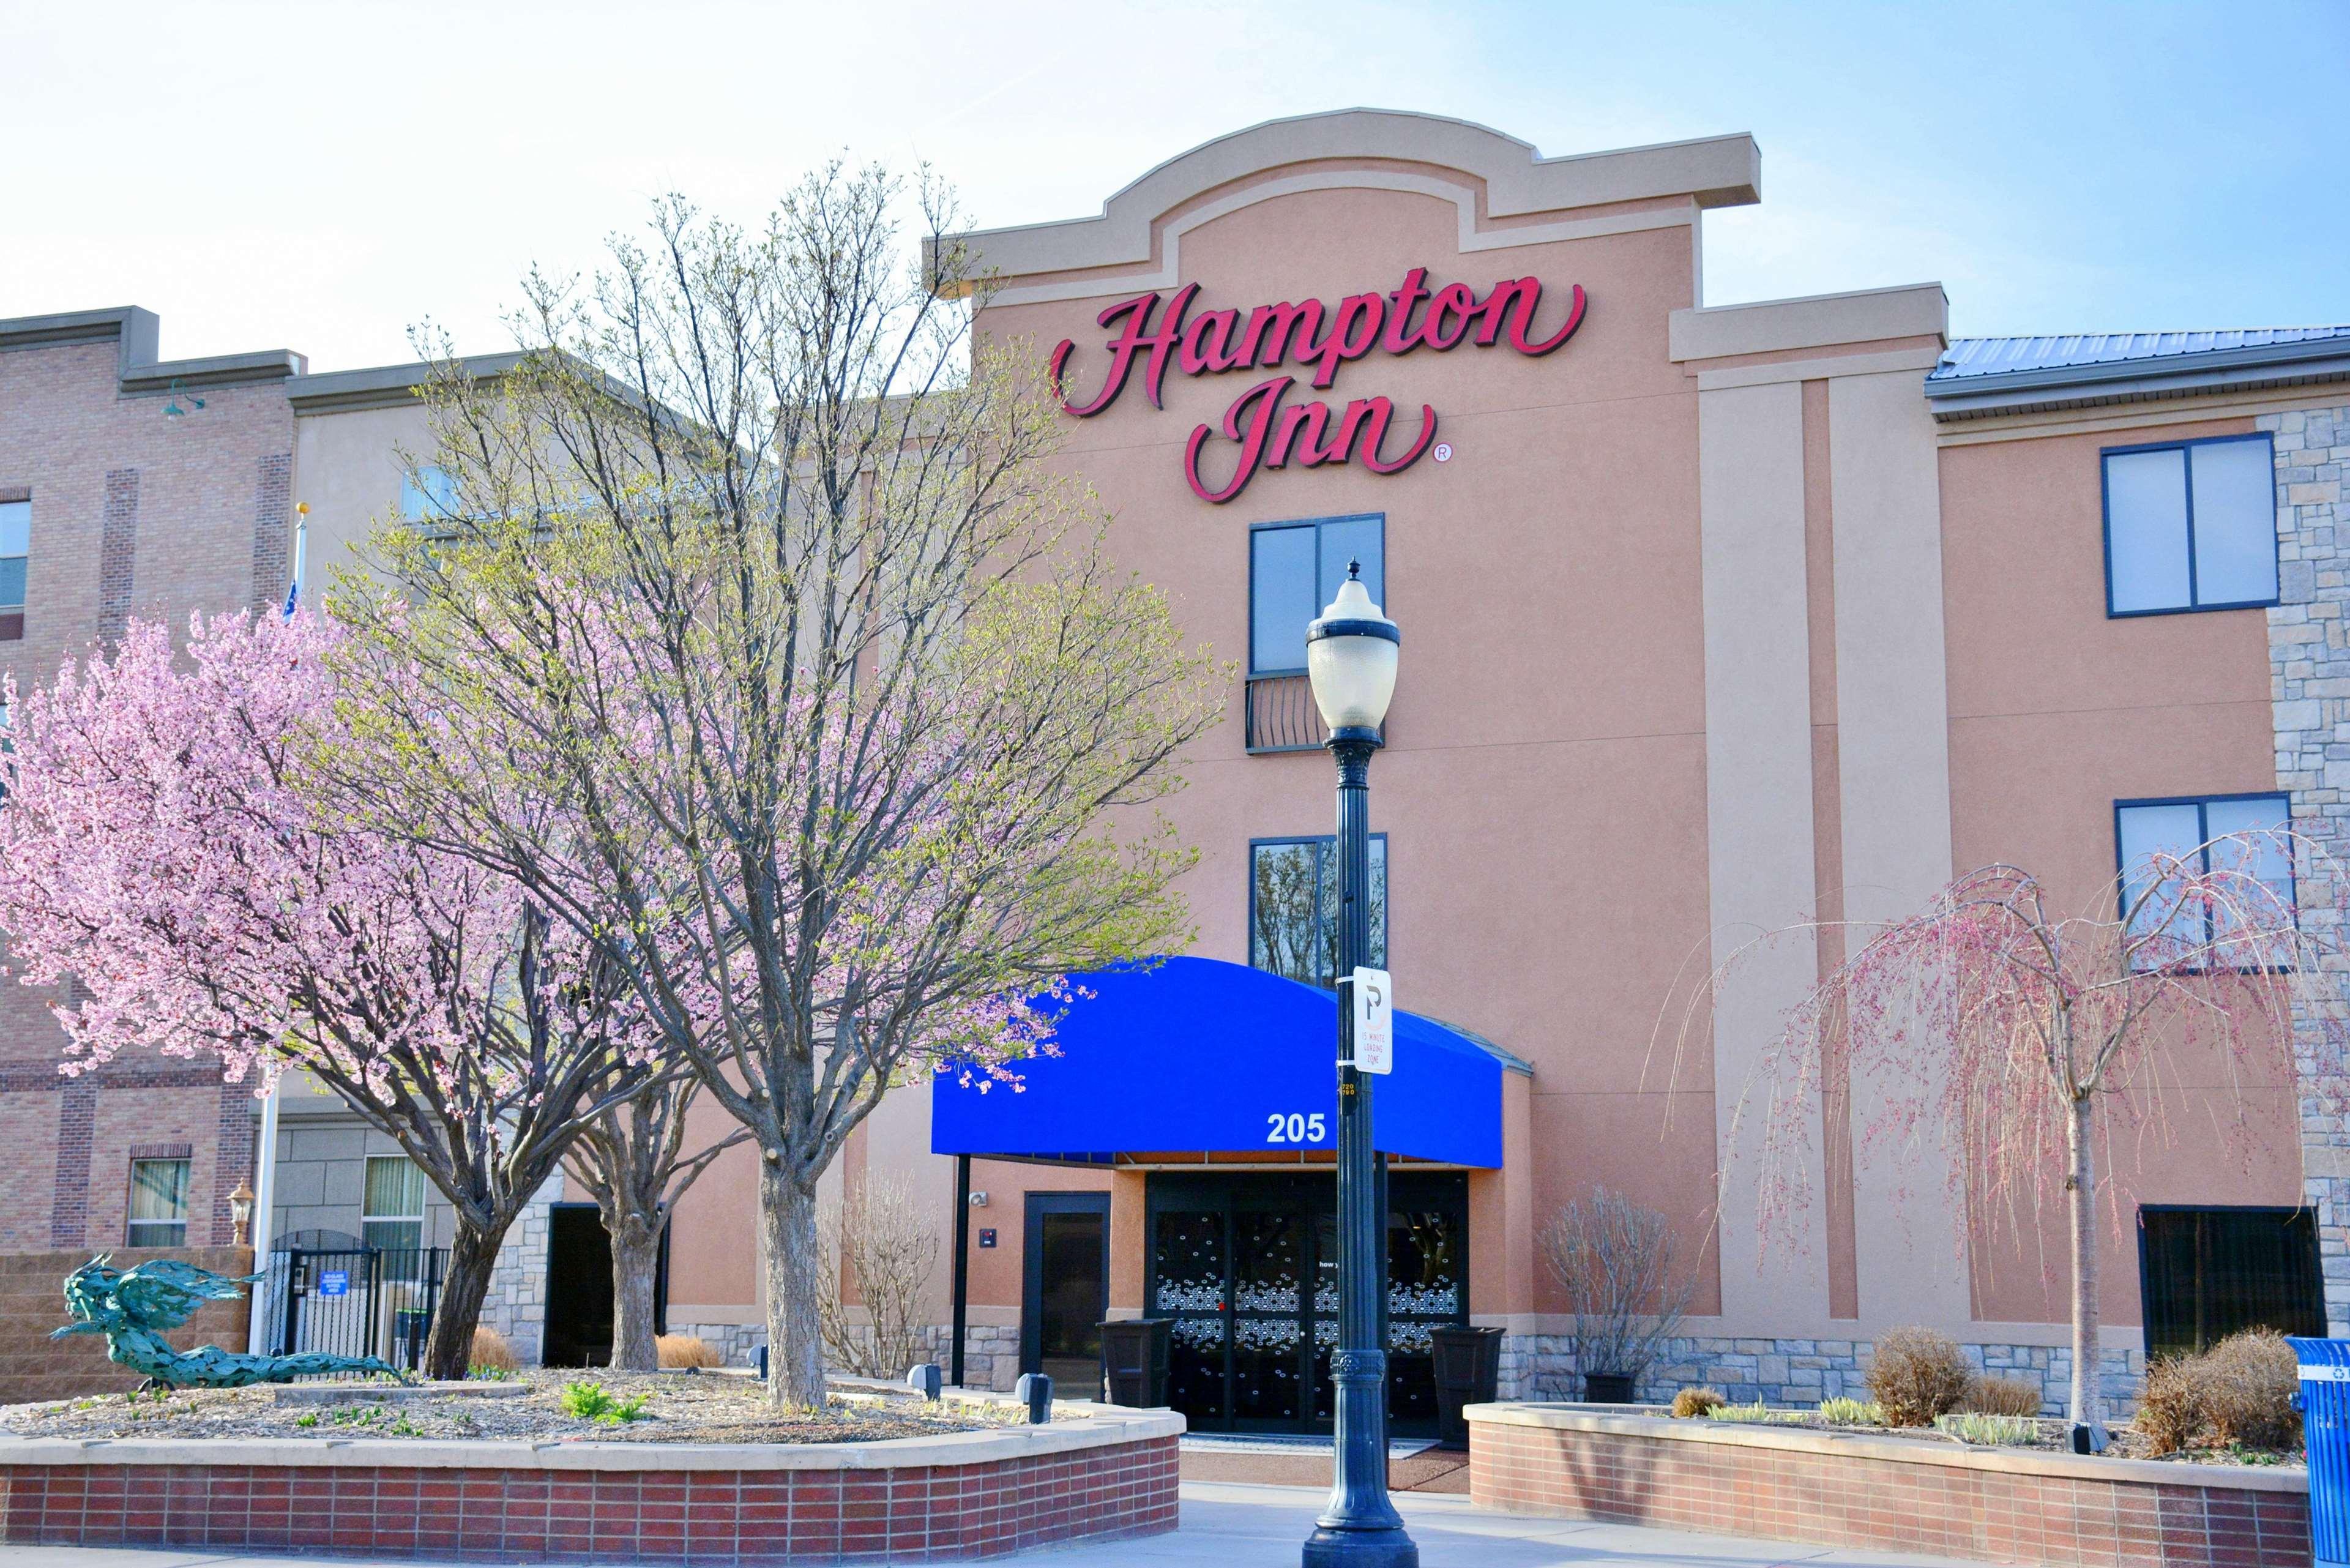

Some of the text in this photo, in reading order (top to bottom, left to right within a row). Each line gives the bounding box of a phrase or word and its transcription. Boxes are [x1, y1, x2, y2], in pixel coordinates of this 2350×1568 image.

[1050, 267, 1588, 418] Hampton
[1184, 375, 1438, 504] Inn
[1364, 1043, 1382, 1053] LOADING
[1370, 1033, 1385, 1043] MINUTE
[1367, 1054, 1379, 1064] ZONE
[1267, 1113, 1326, 1143] 205
